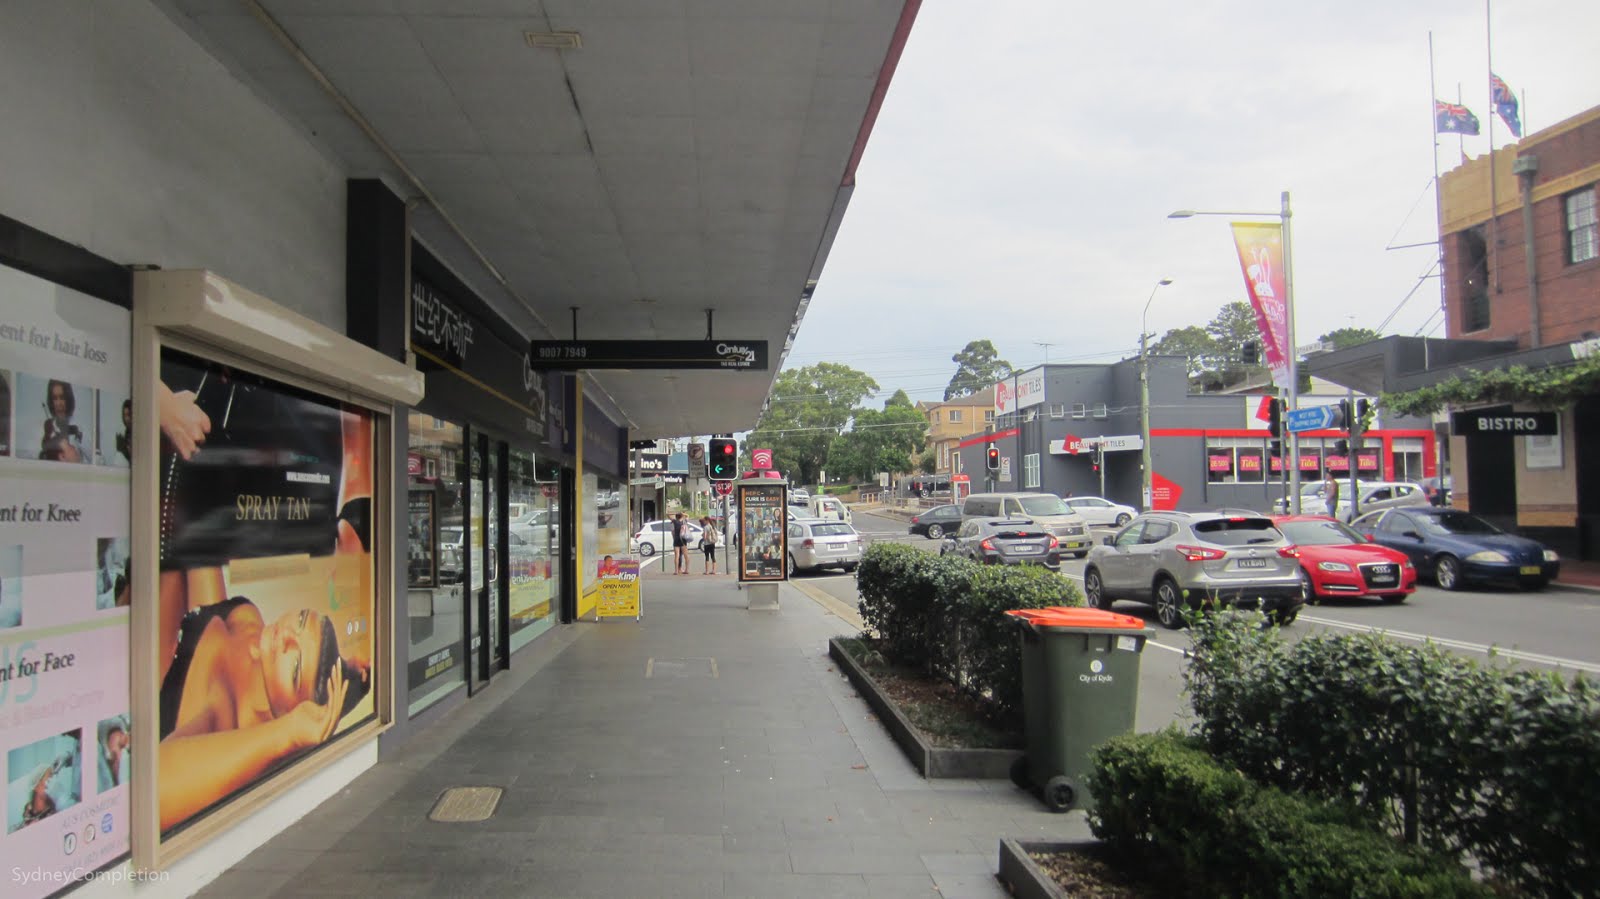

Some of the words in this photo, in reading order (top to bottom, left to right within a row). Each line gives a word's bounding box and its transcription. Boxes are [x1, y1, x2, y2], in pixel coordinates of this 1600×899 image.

[412, 282, 474, 361] 世纪不动产
[29, 326, 51, 349] for
[53, 331, 81, 357] hair
[83, 341, 108, 364] loss
[565, 347, 587, 358] 7949
[716, 343, 748, 355] Century
[745, 350, 755, 361] 21
[1029, 378, 1042, 394] TILES
[1477, 417, 1537, 430] BISTRO
[1110, 440, 1125, 448] TILES
[21, 502, 43, 522] for
[47, 503, 81, 522] Knee
[236, 494, 281, 521] SPRAY
[287, 496, 311, 520] TAN
[17, 657, 40, 678] for
[43, 653, 75, 673] Face
[1080, 674, 1091, 683] City
[1099, 674, 1113, 683] Ryde
